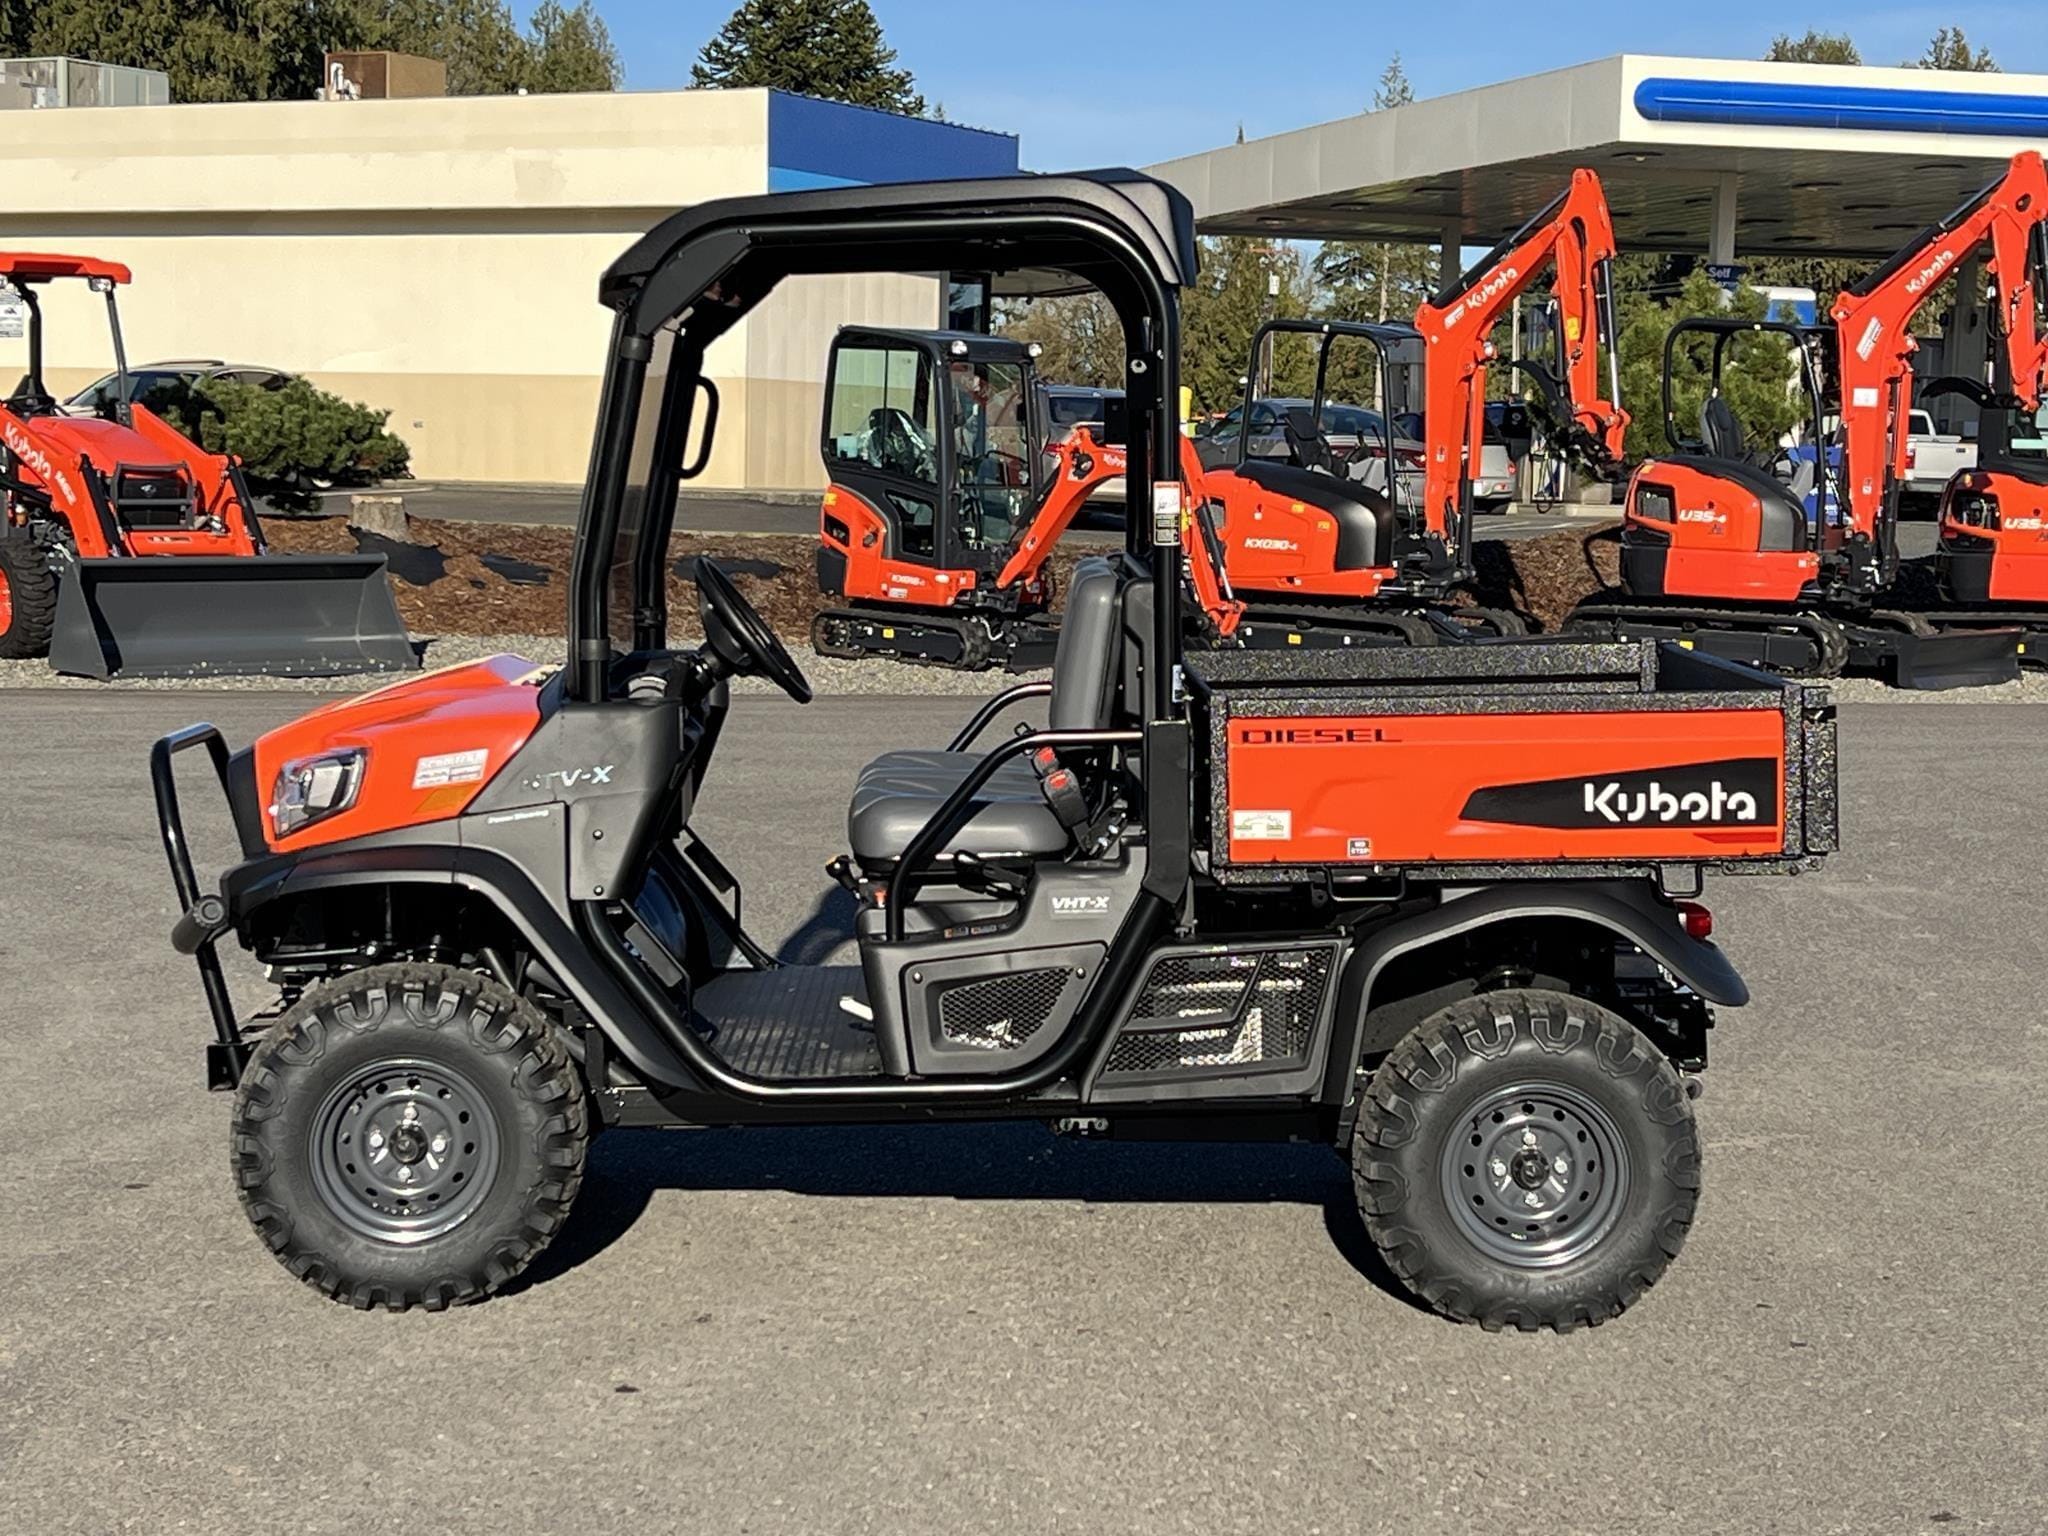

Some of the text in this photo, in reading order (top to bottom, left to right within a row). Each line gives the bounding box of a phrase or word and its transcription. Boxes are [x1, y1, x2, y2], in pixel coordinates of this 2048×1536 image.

[1466, 267, 1519, 310] Kubota
[1904, 250, 1954, 294] Kubota
[4, 421, 52, 481] Kubota
[1242, 728, 1403, 744] DIESEL
[1584, 781, 1757, 822] Kubota
[1051, 896, 1110, 909] VHT-X
